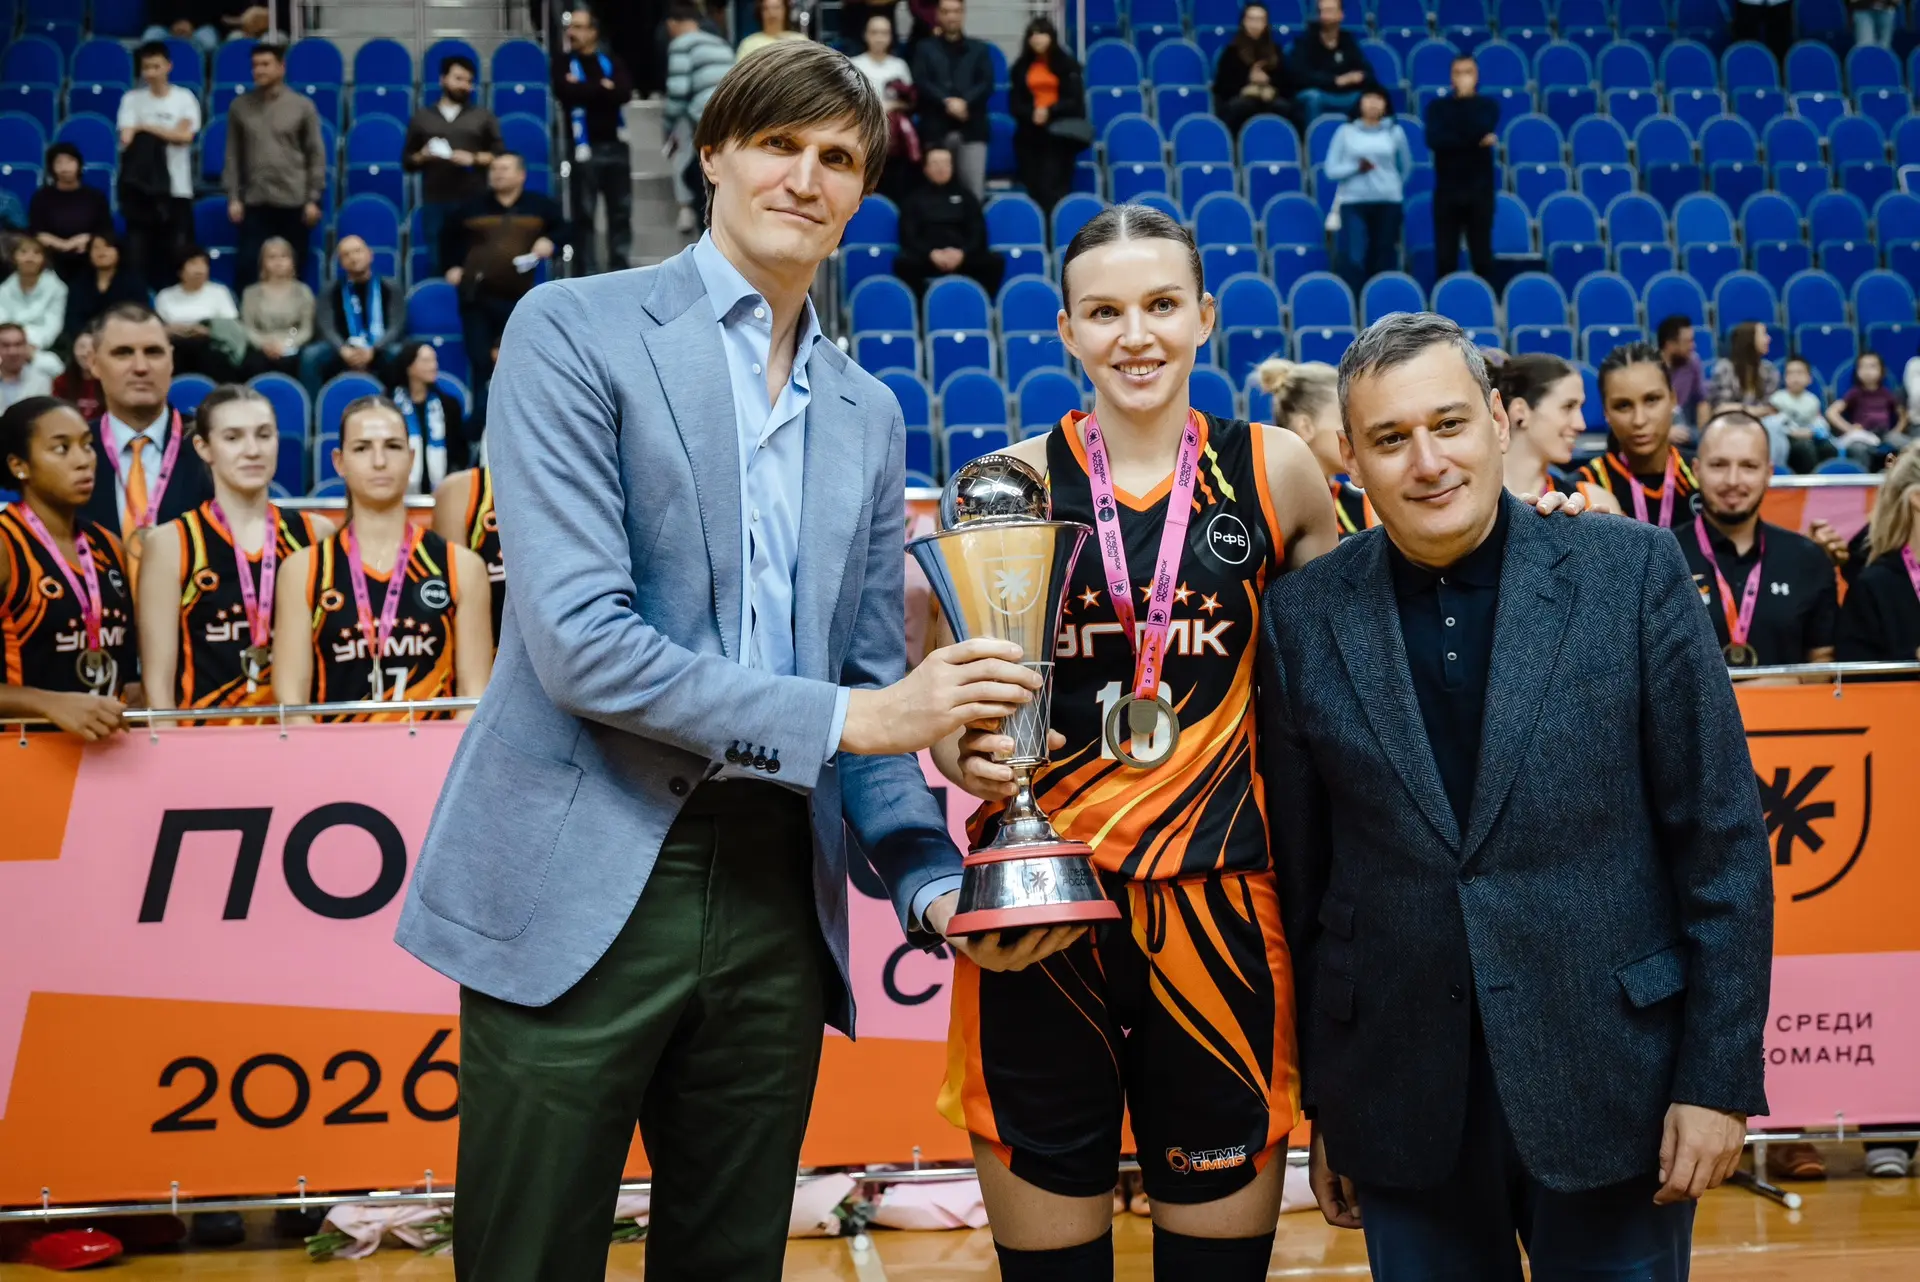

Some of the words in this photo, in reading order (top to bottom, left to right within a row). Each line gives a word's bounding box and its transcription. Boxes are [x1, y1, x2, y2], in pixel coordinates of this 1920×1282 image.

[1213, 531, 1246, 547] РФБ
[1776, 1012, 1873, 1034] СРЕДИ
[1768, 1044, 1875, 1066] ОМАНД
[151, 1027, 459, 1133] 2026
[1190, 1144, 1246, 1161] УГМК
